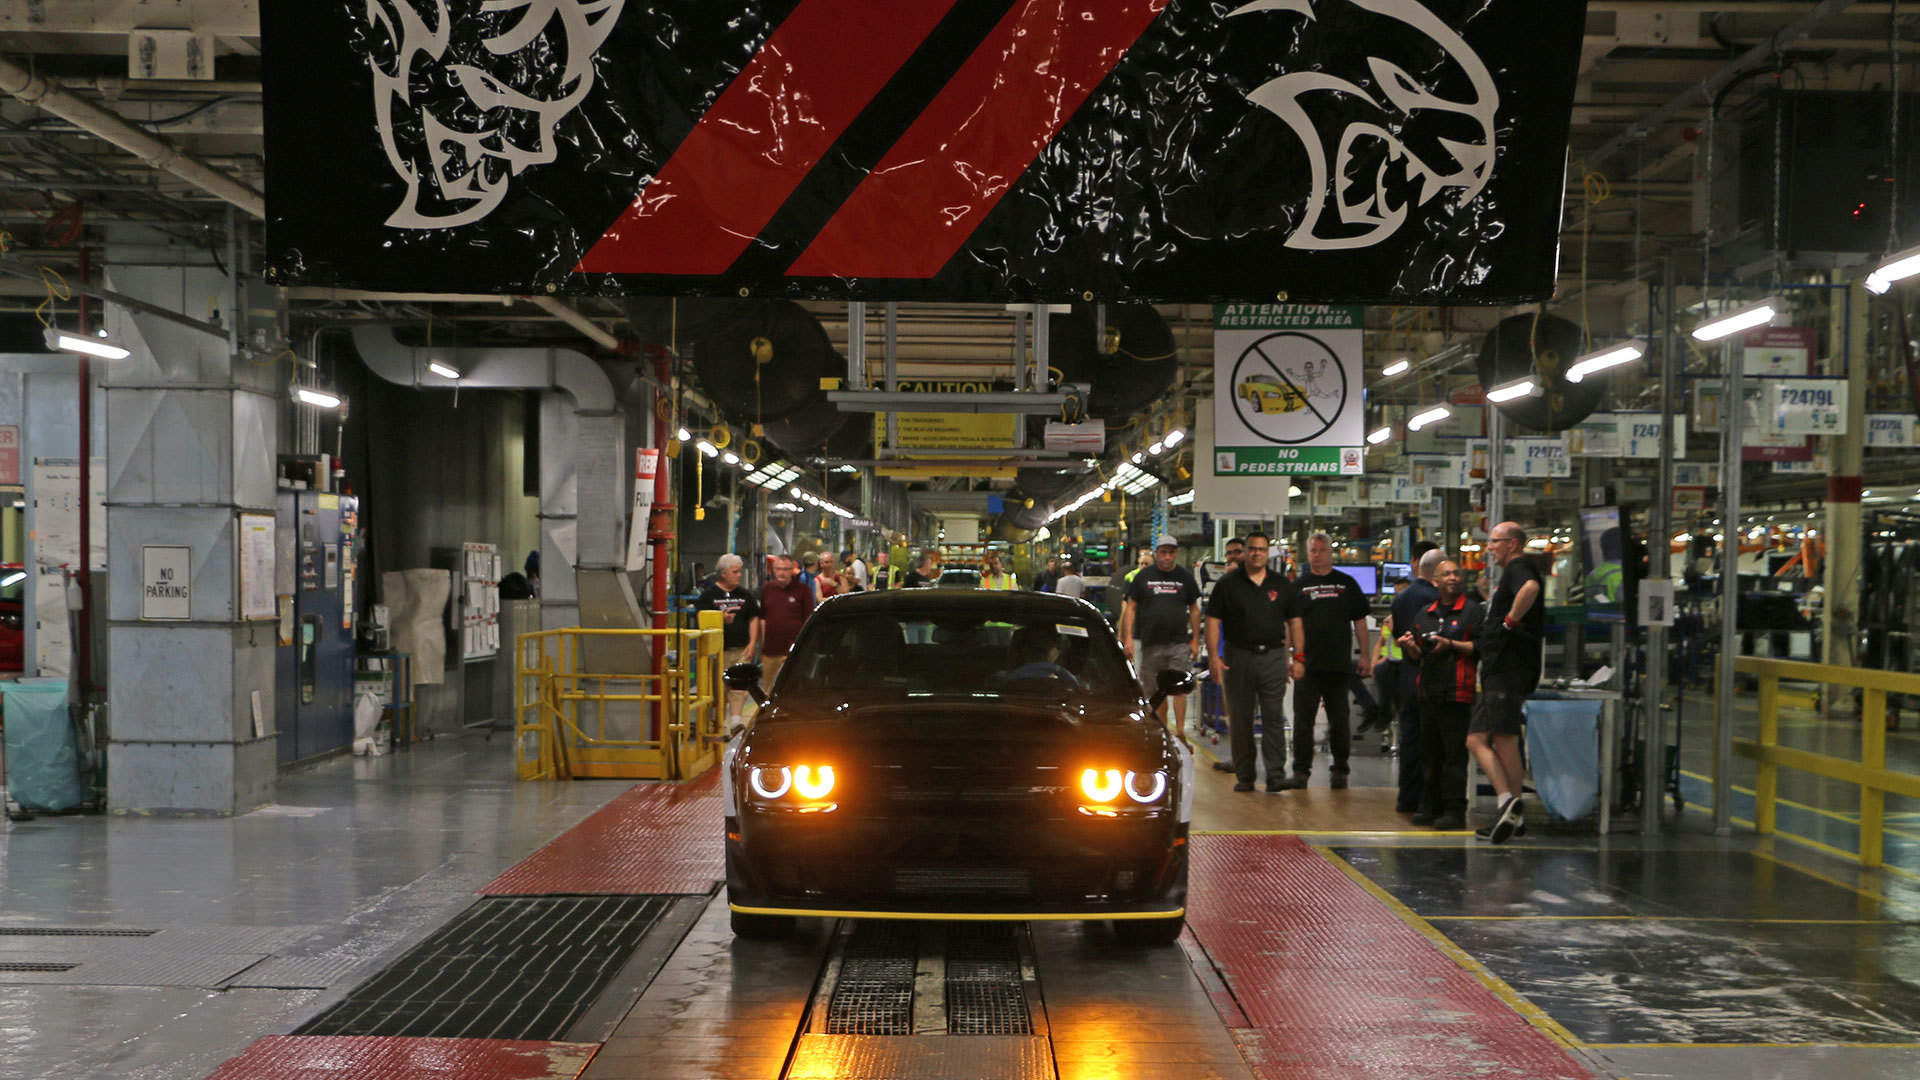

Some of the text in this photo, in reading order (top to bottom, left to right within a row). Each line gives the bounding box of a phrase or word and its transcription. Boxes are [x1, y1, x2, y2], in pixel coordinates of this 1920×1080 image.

[1225, 304, 1348, 315] ATTENTION...
[1220, 315, 1352, 325] RESTRICTED AREA
[897, 382, 992, 393] CAUTION
[1781, 389, 1834, 406] F2479L
[1633, 424, 1661, 438] F247
[1278, 449, 1299, 459] NO
[1239, 462, 1338, 473] PEDESTRIANS
[160, 568, 174, 580] NO
[146, 585, 188, 598] PARKING
